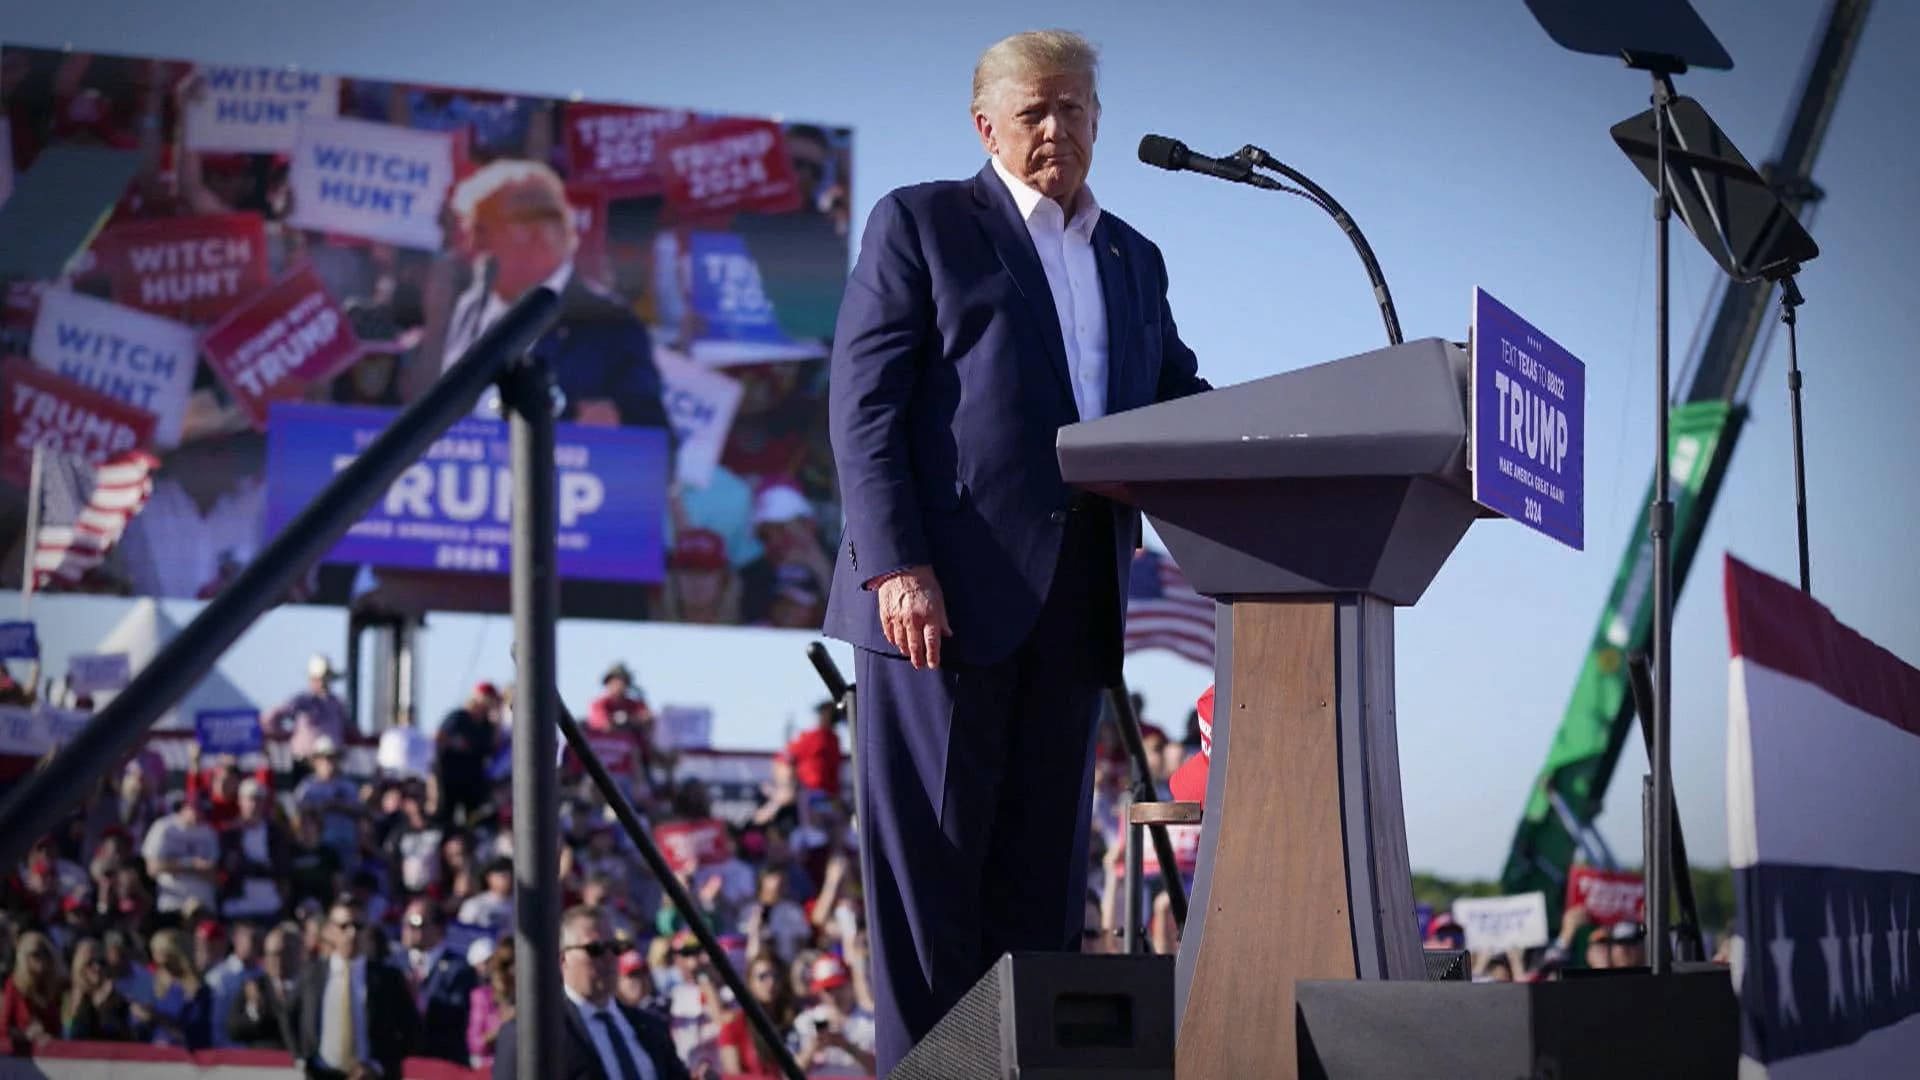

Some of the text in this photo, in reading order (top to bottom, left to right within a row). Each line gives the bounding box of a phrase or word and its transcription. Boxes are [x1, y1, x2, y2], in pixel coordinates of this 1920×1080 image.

[209, 66, 321, 92] WITCH
[313, 143, 431, 187] WITCH
[671, 129, 774, 176] TRUMP
[320, 178, 417, 216] HUNT
[131, 238, 251, 274] WITCH
[142, 269, 241, 304] HUNT
[56, 322, 178, 379] WITCH
[236, 308, 339, 396] TRUMP
[1501, 338, 1518, 368] TEXT
[1518, 350, 1538, 383] TEXAS
[1538, 364, 1547, 389] TO
[13, 380, 137, 451] TRUMP
[1496, 370, 1568, 474] TRUMP
[332, 454, 605, 528] RUP
[1499, 456, 1513, 478] MAKE
[1513, 464, 1534, 489] AMERICA
[1535, 475, 1549, 496] GREAT
[1524, 496, 1542, 526] 2024
